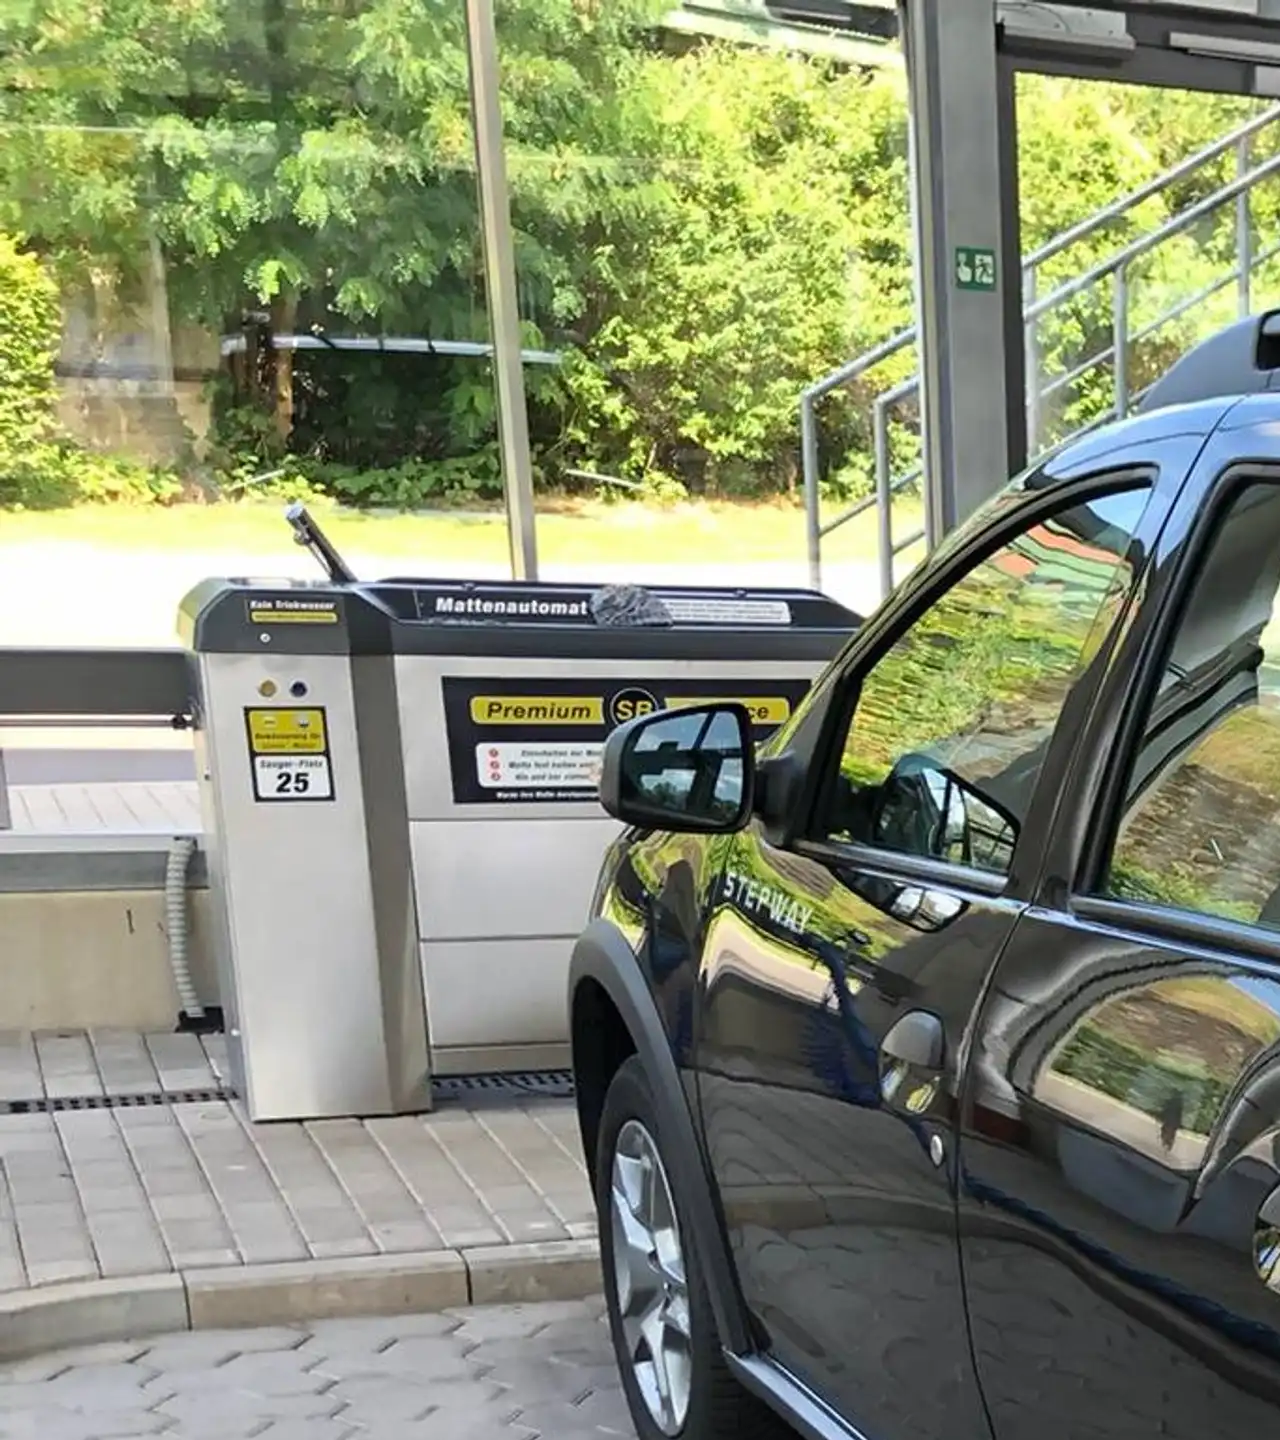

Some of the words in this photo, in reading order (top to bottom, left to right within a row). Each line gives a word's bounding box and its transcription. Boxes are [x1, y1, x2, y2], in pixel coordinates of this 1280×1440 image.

[435, 597, 588, 615] Mattenautomat
[487, 702, 591, 719] Premium
[276, 772, 310, 793] 25
[723, 871, 814, 935] STEPWAY
